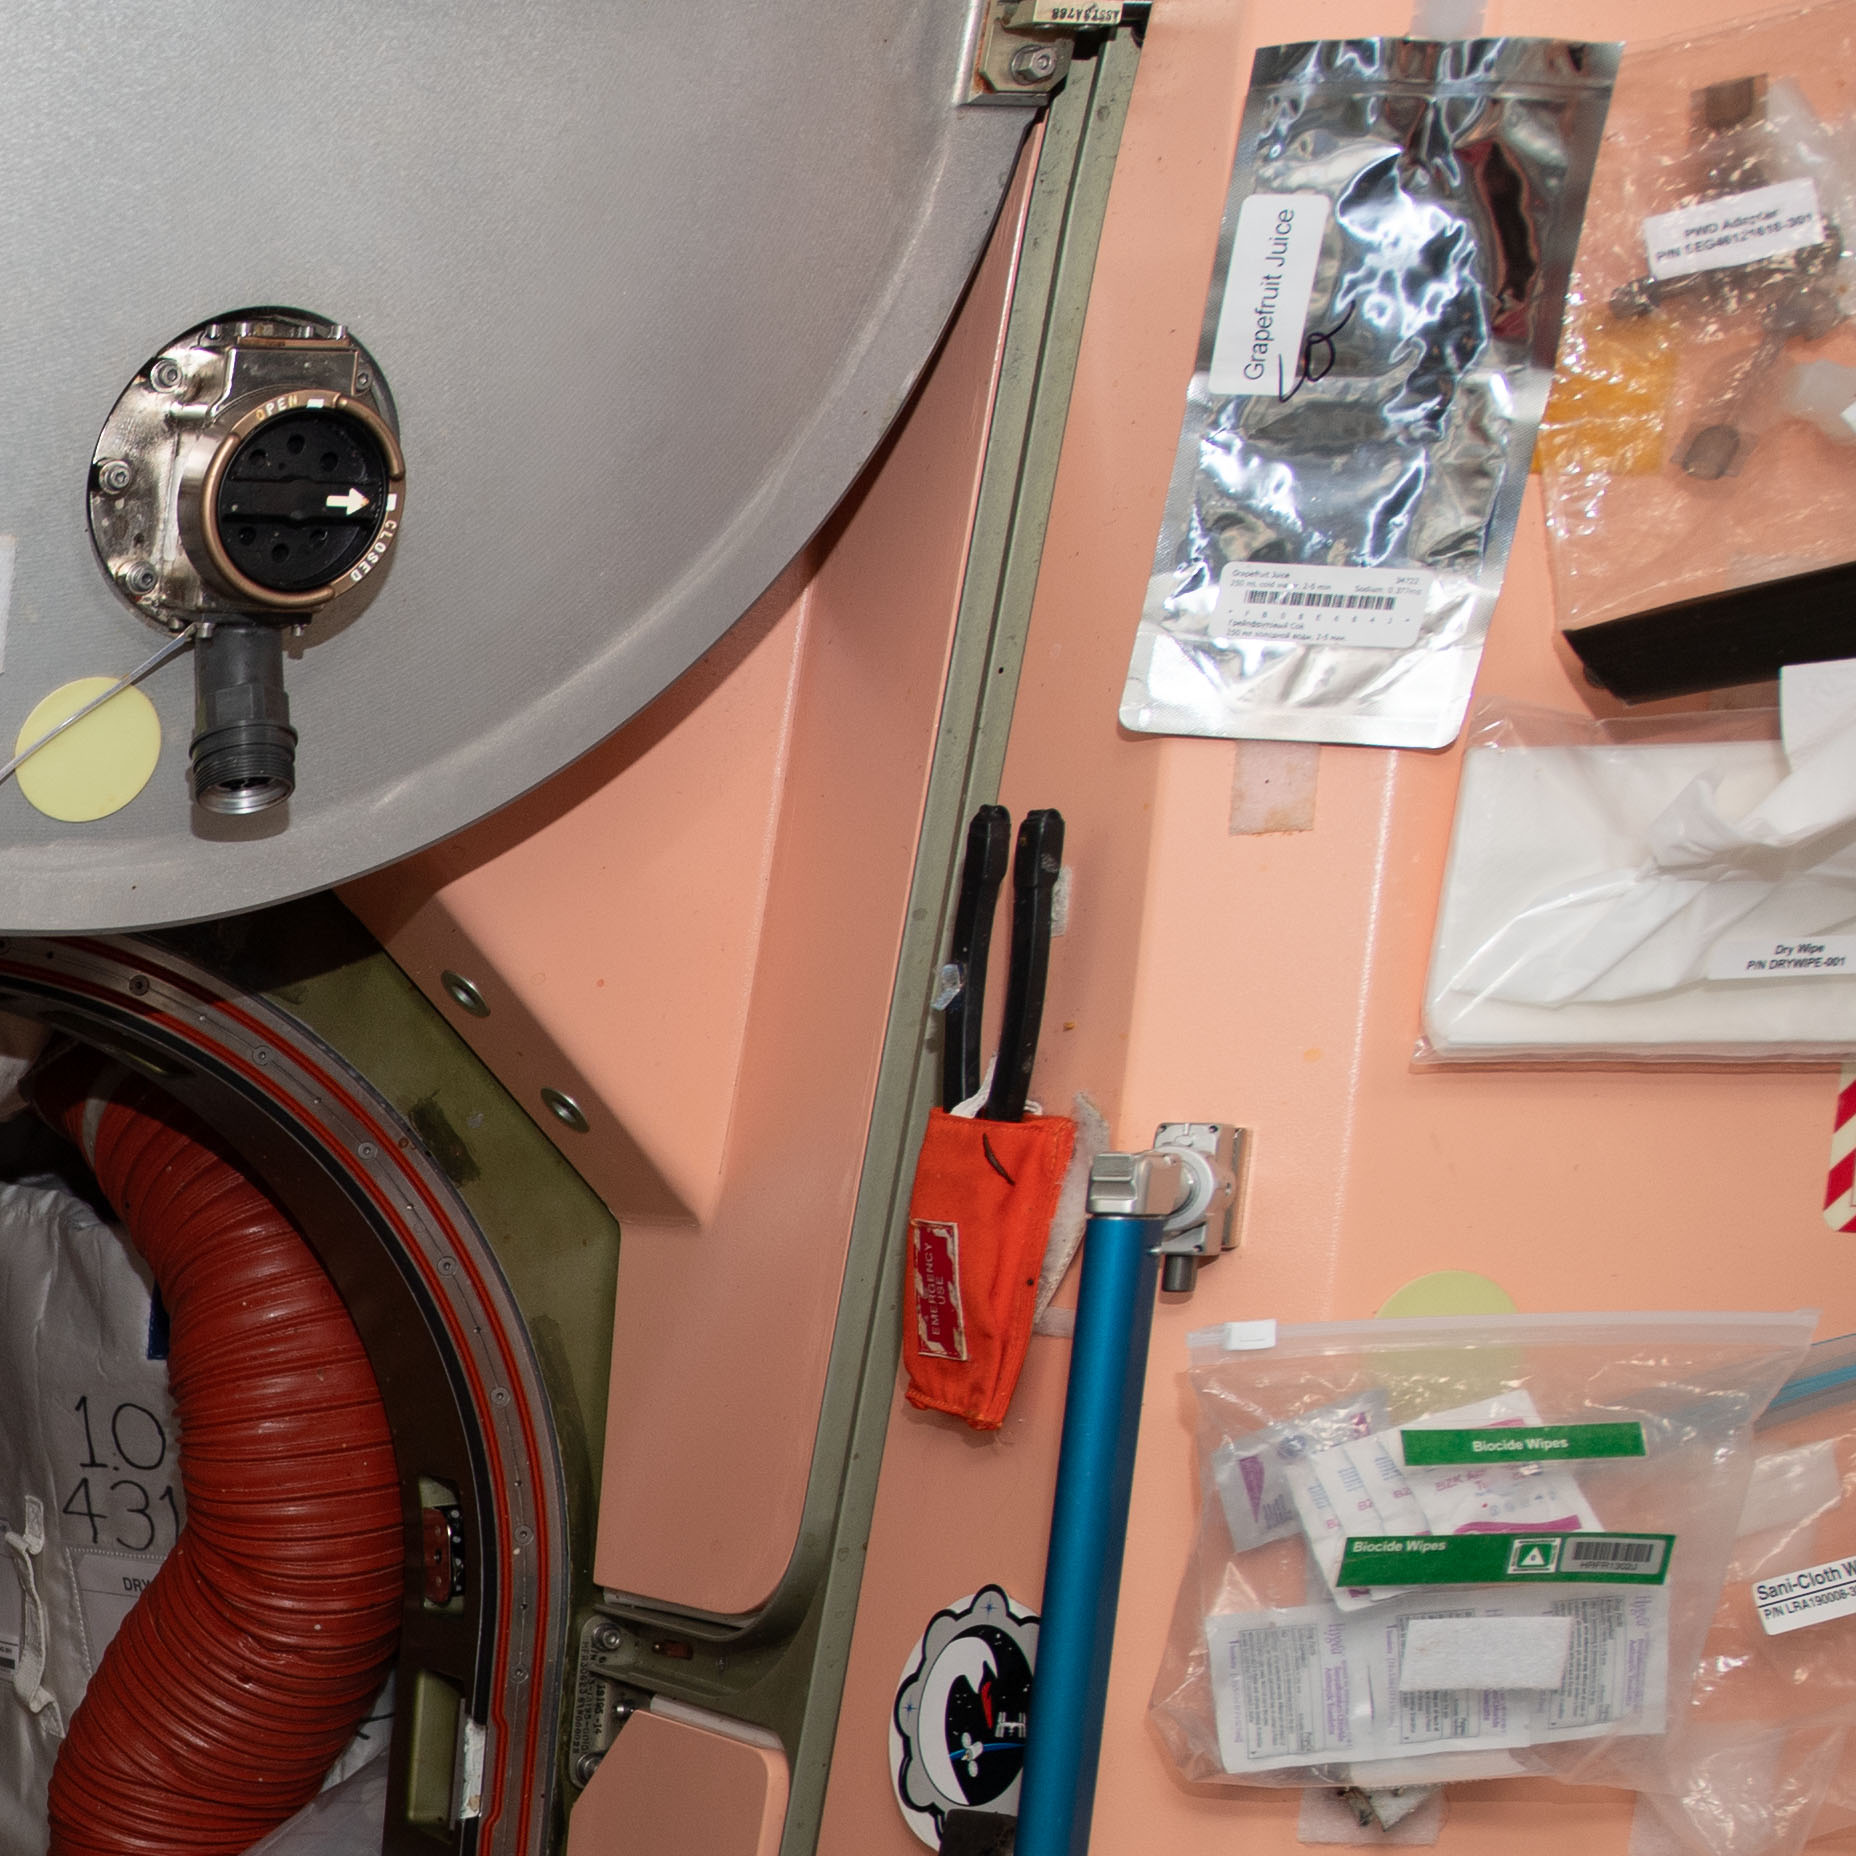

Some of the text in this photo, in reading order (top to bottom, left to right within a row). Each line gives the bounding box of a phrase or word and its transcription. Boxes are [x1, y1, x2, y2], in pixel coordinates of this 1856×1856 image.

[1684, 222, 1718, 237] PWD
[1244, 208, 1295, 380] Grapefruit Juice
[255, 396, 297, 420] OPEN
[350, 520, 397, 582] CLOSED
[1775, 943, 1825, 955] Dry Wipe
[1746, 960, 1767, 970] P/N
[926, 1242, 940, 1336] EMERGENCY
[937, 1276, 946, 1305] USE
[75, 1395, 167, 1471] 1.0
[1472, 1436, 1568, 1453] Biocide Wipes
[1353, 1539, 1446, 1554] Biocide Wipes
[1757, 1567, 1842, 1600] Sani-Cloth
[1764, 1607, 1784, 1620] P/N
